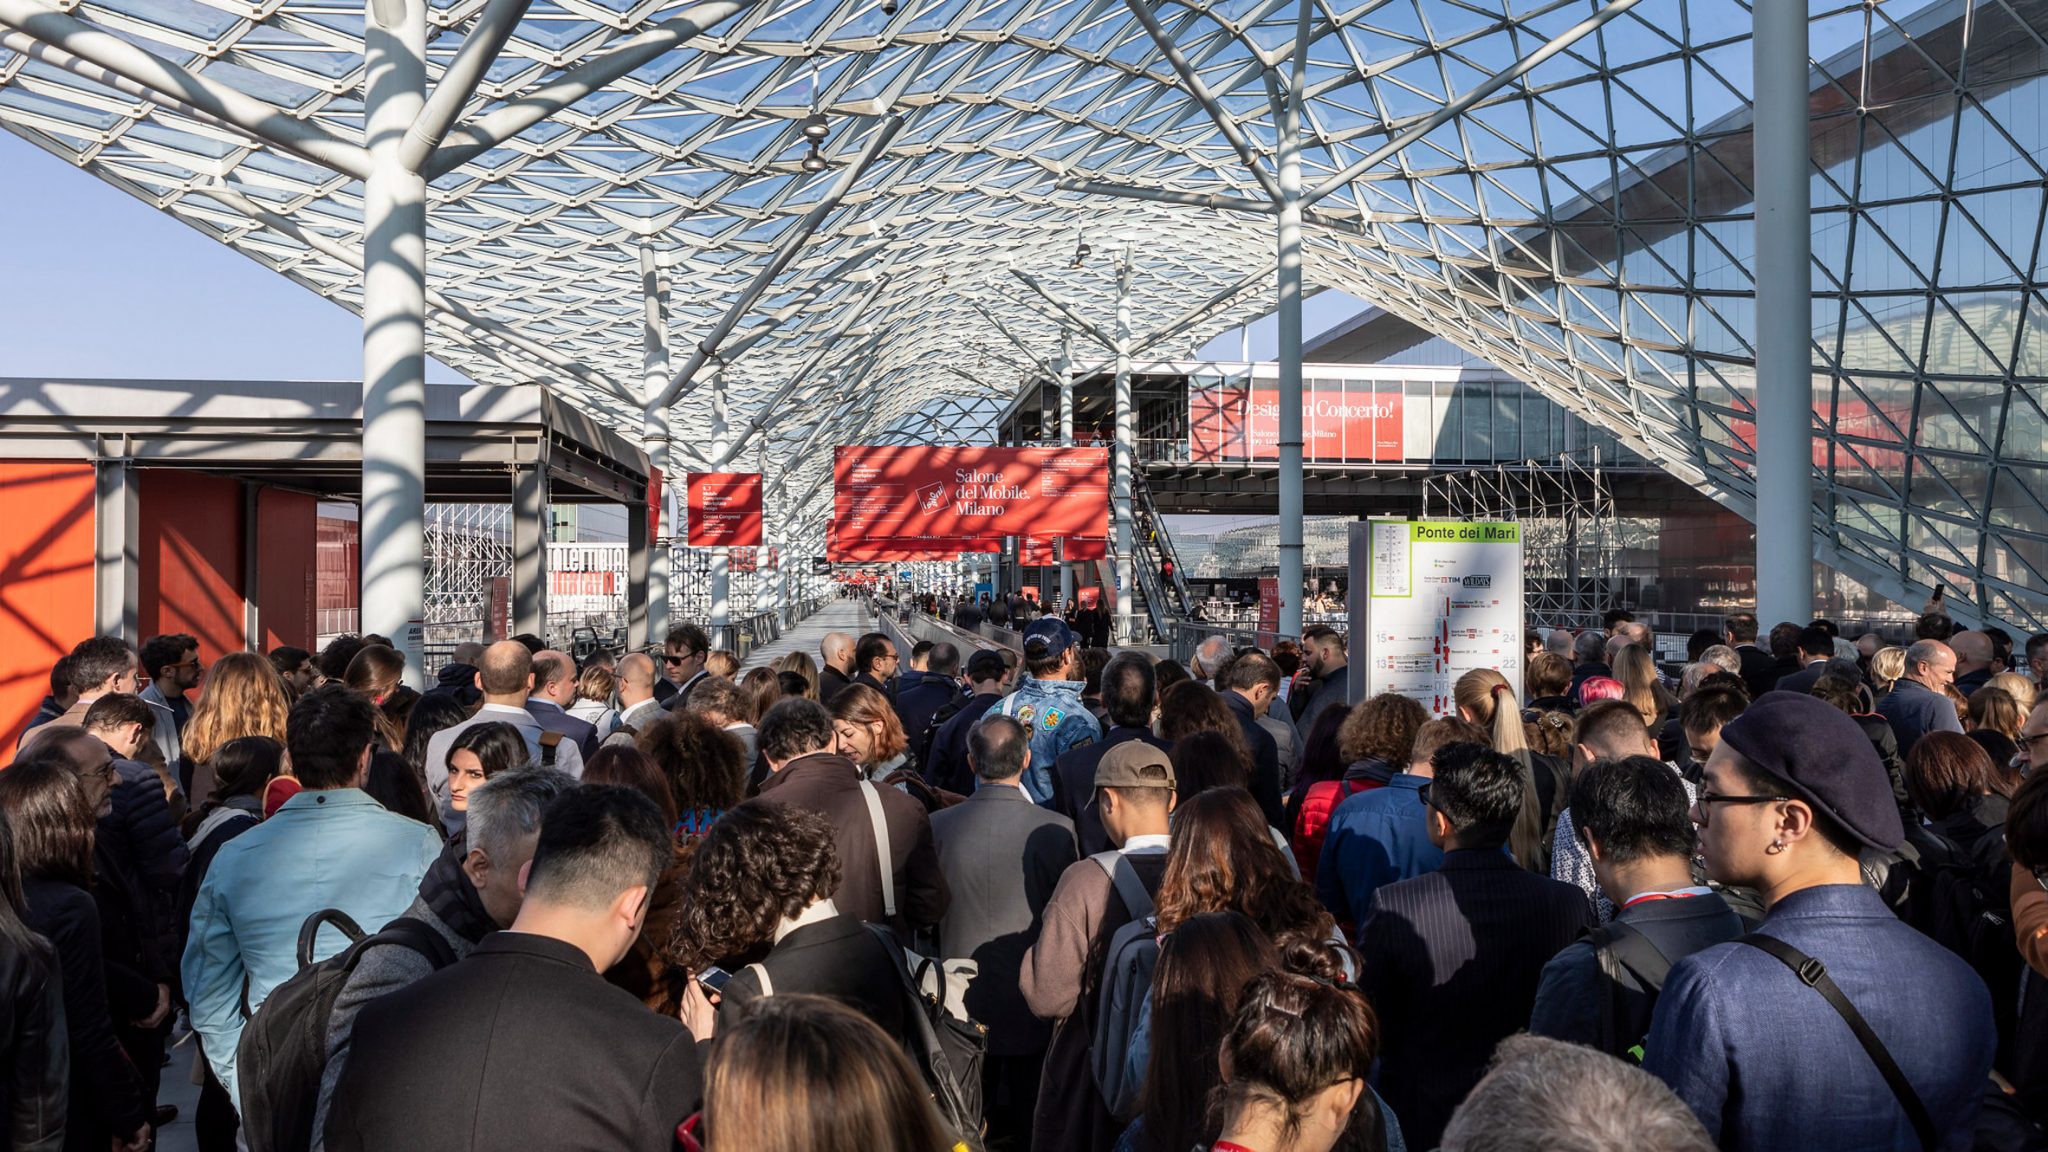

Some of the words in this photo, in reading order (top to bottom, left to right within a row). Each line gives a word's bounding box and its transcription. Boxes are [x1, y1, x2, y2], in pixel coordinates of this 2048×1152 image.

[1237, 399, 1280, 420] Desig
[1316, 399, 1394, 419] Concerto!
[955, 468, 1004, 484] Salone
[955, 485, 977, 499] del
[979, 485, 1031, 499] Mobile.
[955, 502, 1005, 516] Milano
[1417, 526, 1455, 539] Ponte
[1459, 526, 1480, 539] dei
[1484, 527, 1516, 540] Mari
[1376, 634, 1387, 643] 15
[1503, 634, 1516, 643] 24
[1376, 660, 1387, 669] 13
[1503, 659, 1517, 669] 22
